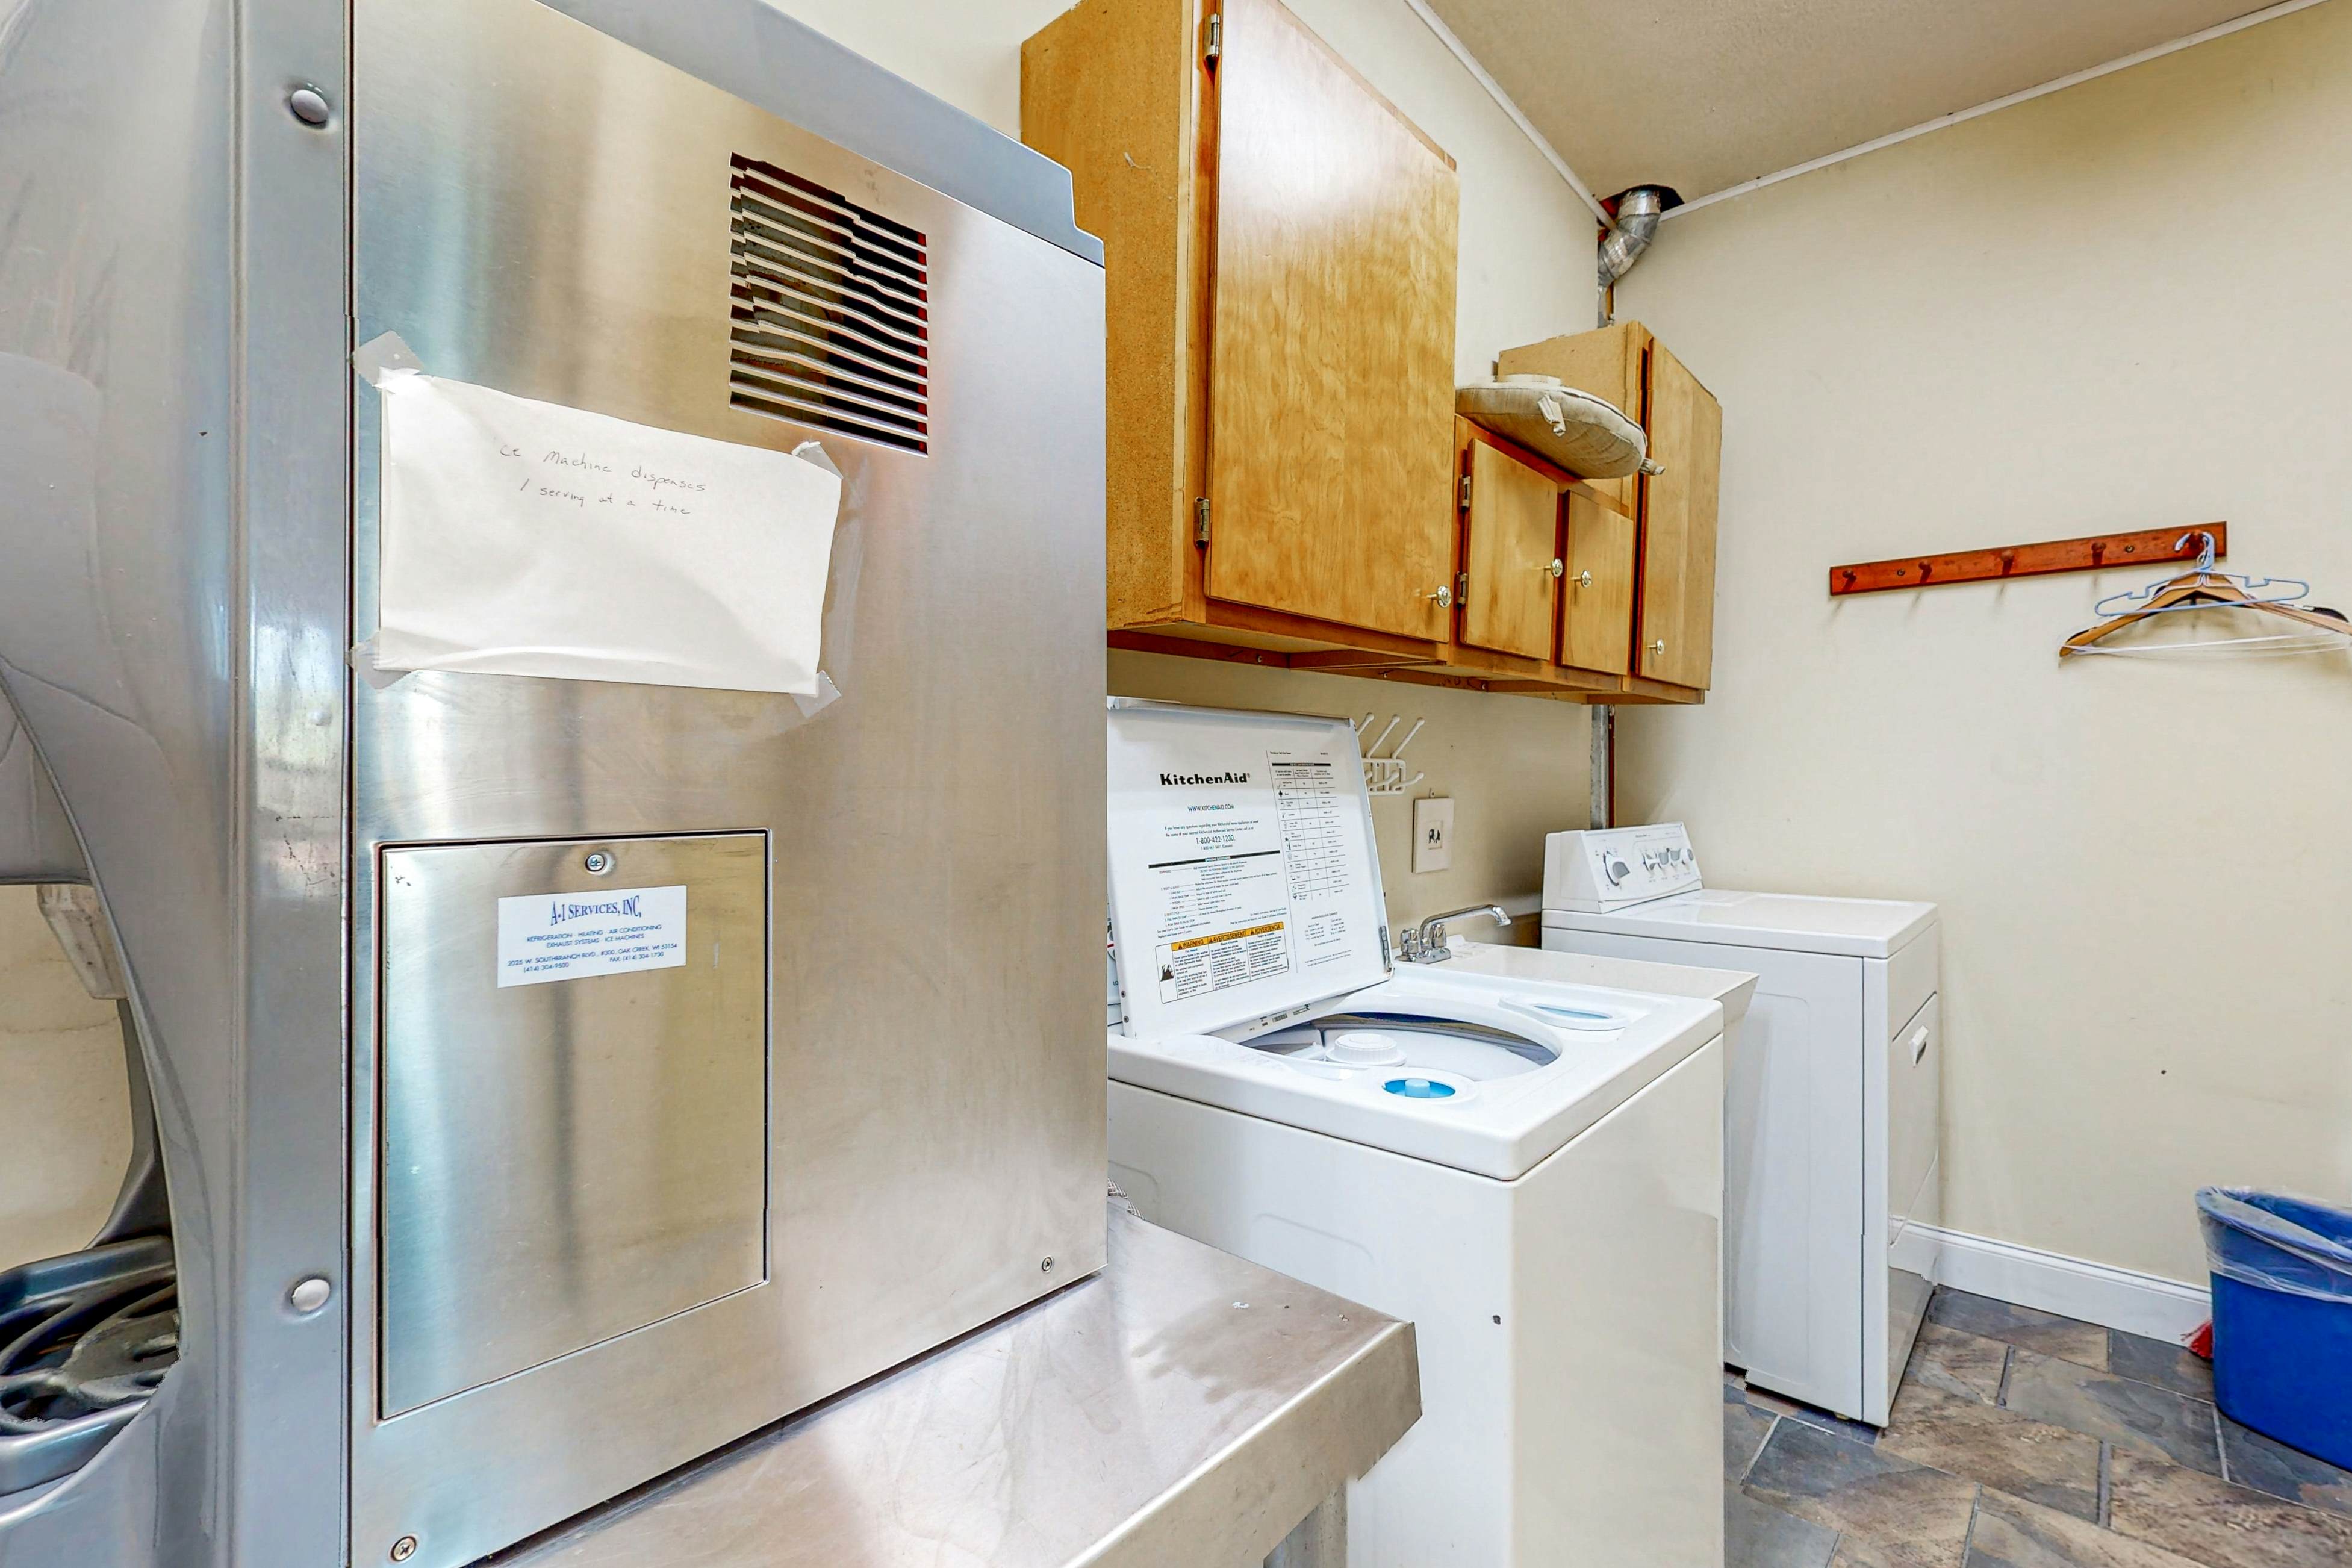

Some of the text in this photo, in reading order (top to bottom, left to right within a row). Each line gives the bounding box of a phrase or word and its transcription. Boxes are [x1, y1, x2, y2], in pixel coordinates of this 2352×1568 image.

[543, 451, 612, 473] Machine
[631, 466, 706, 492] dispenses
[540, 486, 584, 506] serving
[599, 493, 613, 504] at
[653, 500, 691, 515] time
[1188, 803, 1234, 812] WWW.KITCHENAID.COM
[551, 901, 566, 926] A-1
[568, 902, 620, 919] SERVICES,
[526, 933, 573, 942] REFRIGERATION
[619, 924, 662, 933] CONDITIONING
[546, 940, 573, 948] EXHAUST
[1183, 939, 1204, 949] WARNING
